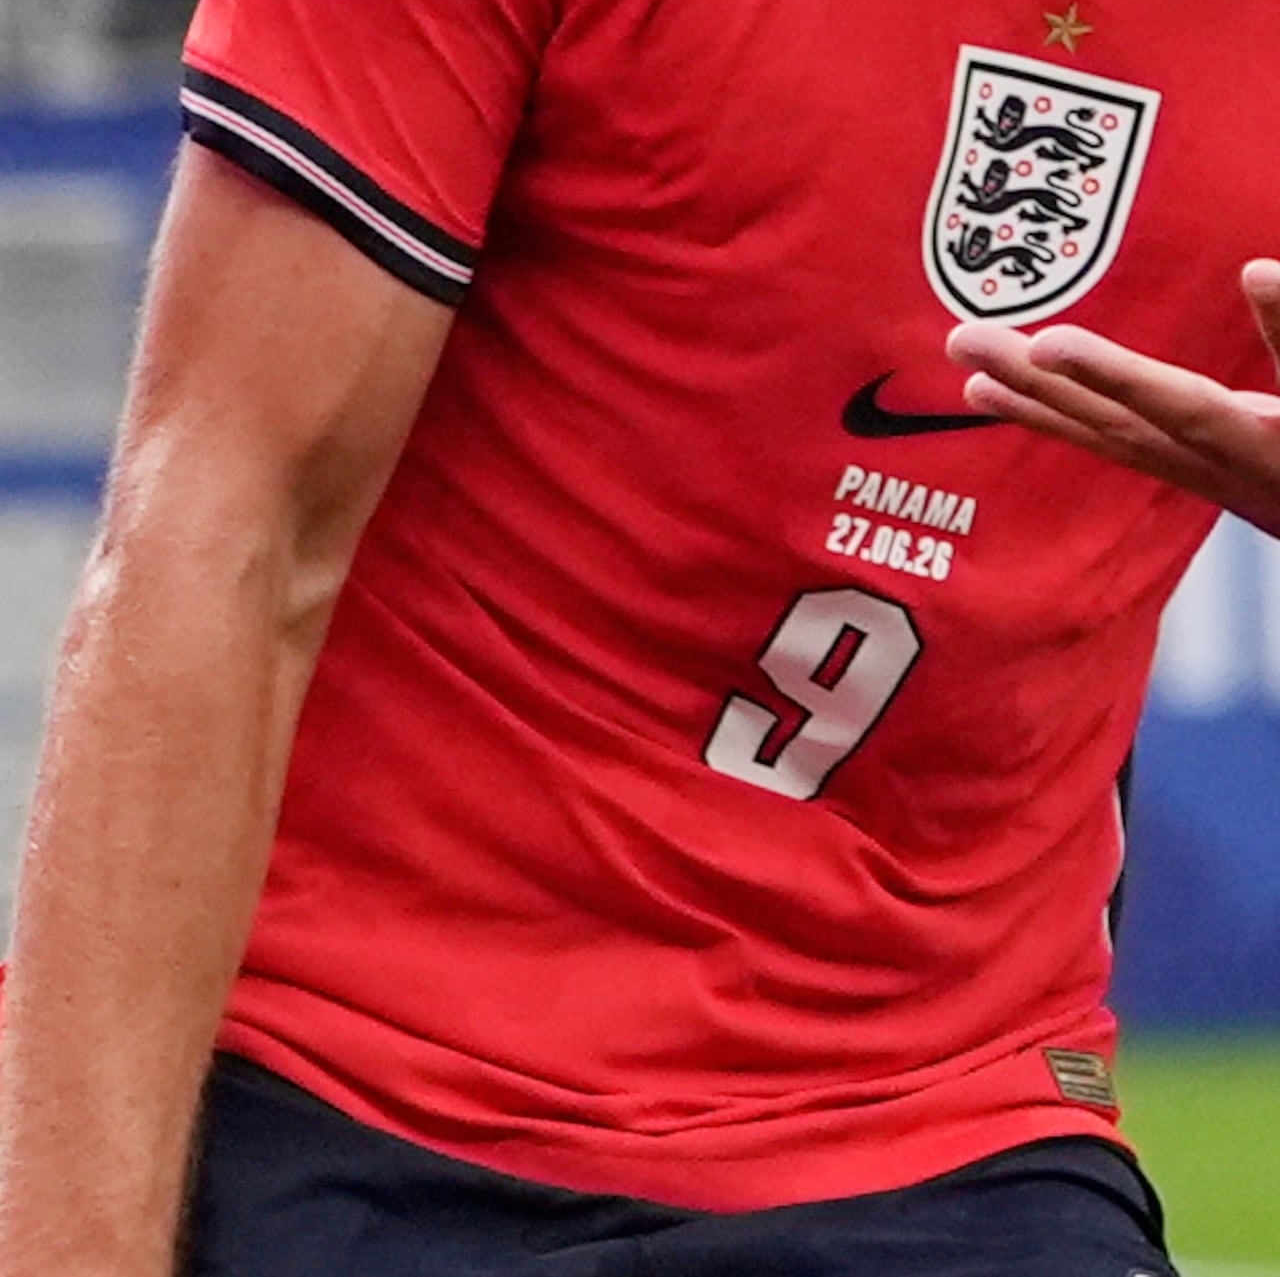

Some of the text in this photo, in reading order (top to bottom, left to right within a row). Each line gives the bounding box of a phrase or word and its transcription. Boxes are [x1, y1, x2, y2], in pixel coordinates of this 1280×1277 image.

[834, 464, 977, 535] PANAMA
[825, 513, 954, 582] 27.06.26
[703, 588, 924, 801] 9
